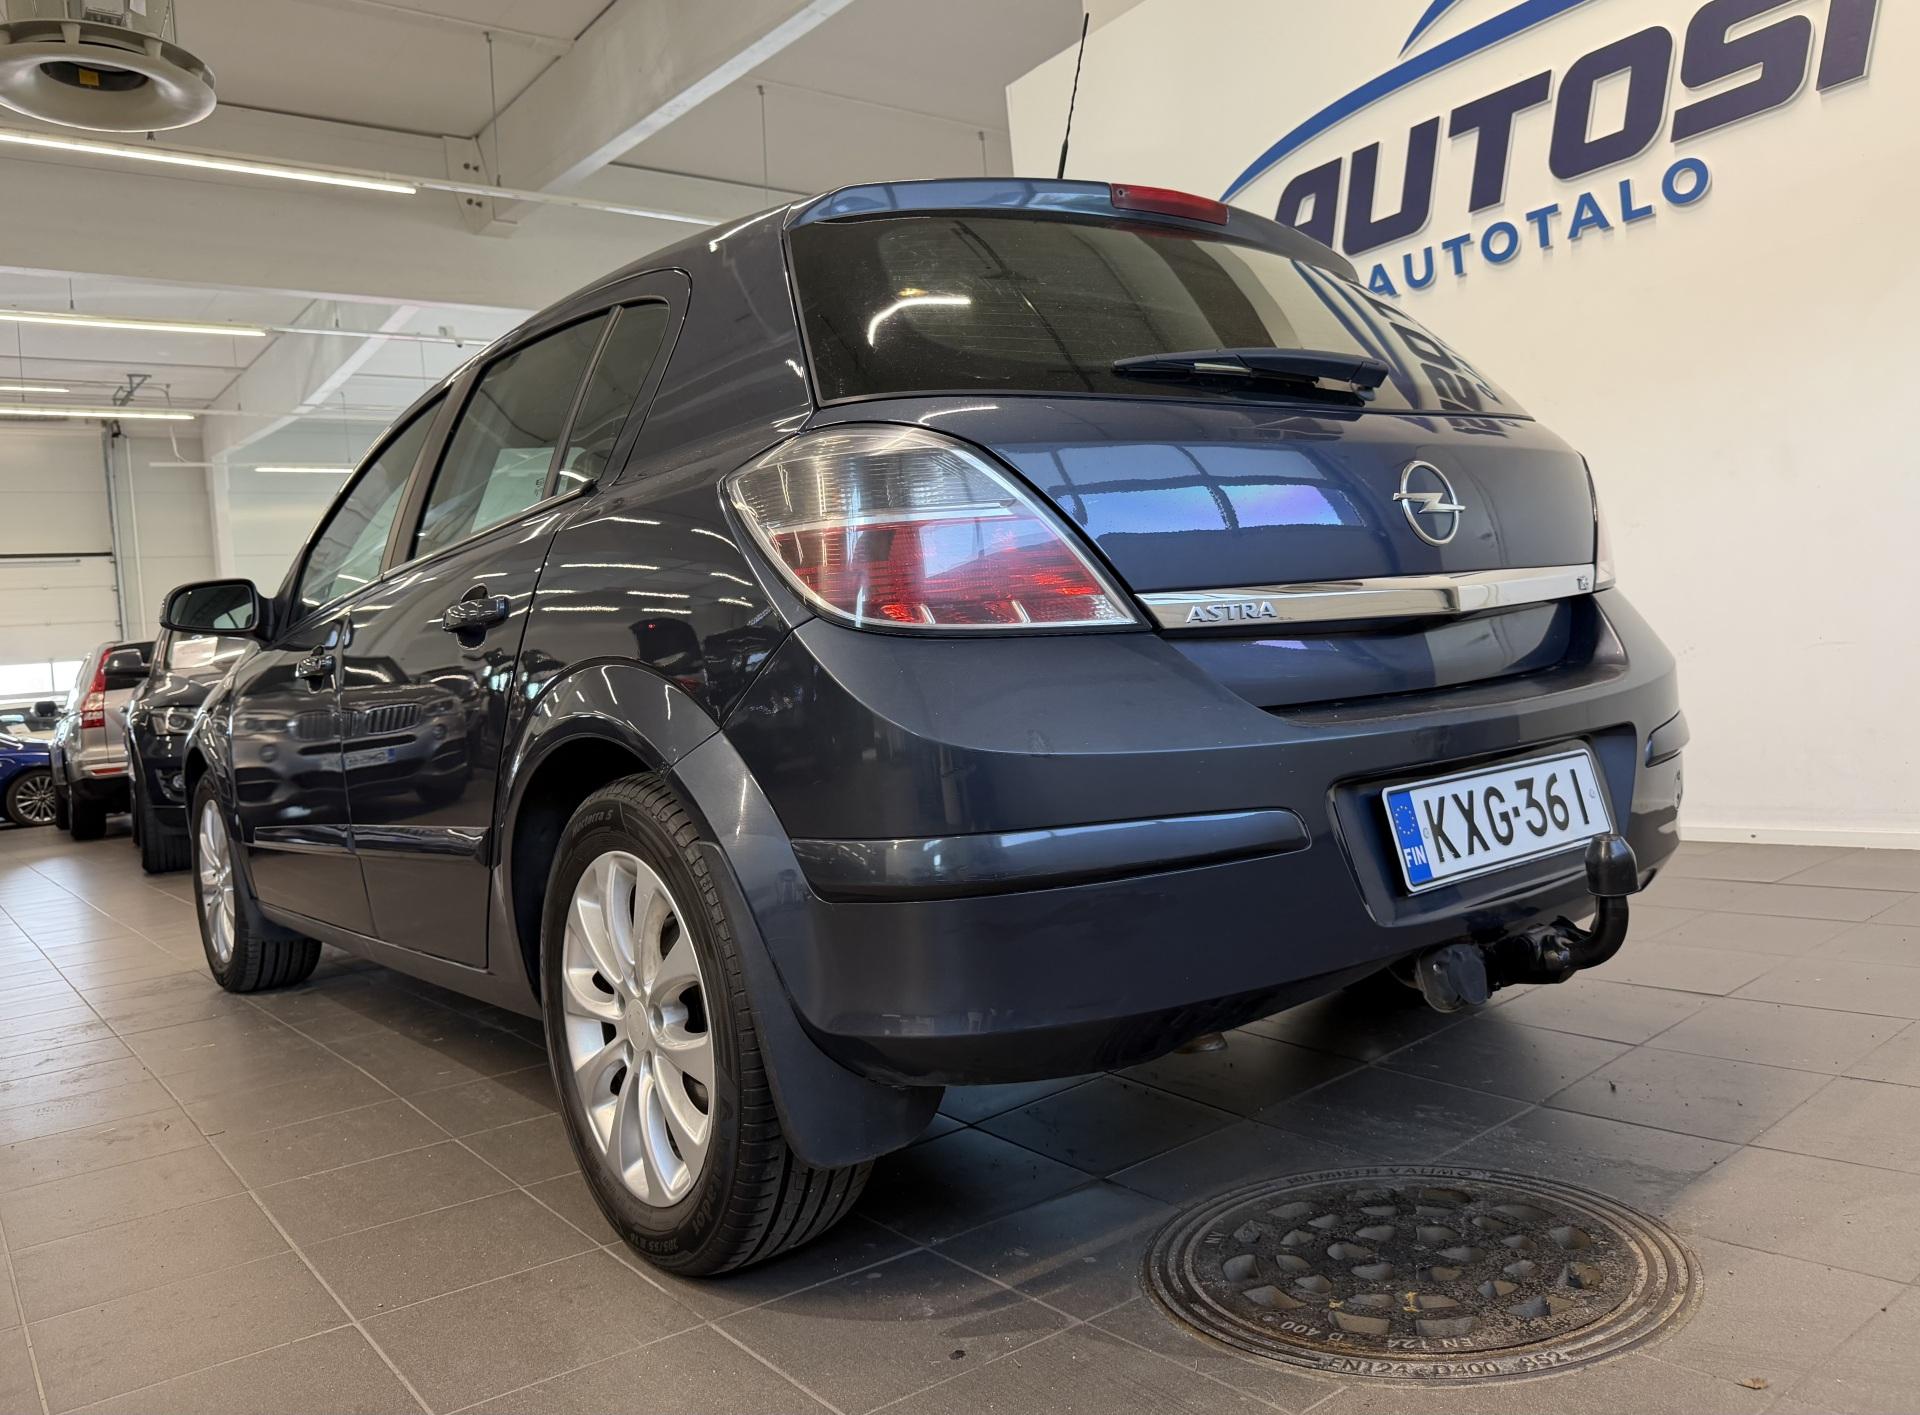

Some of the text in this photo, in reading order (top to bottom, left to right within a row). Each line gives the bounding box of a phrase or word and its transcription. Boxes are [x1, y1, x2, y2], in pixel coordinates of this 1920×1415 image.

[1368, 157, 1711, 298] AUTOTALO
[1186, 601, 1277, 623] ASTRA
[1423, 768, 1590, 863] KXG-361
[1403, 844, 1427, 868] FIN
[1280, 1320, 1321, 1337] 400
[1386, 1338, 1428, 1350] 124
[1441, 1337, 1474, 1349] EN
